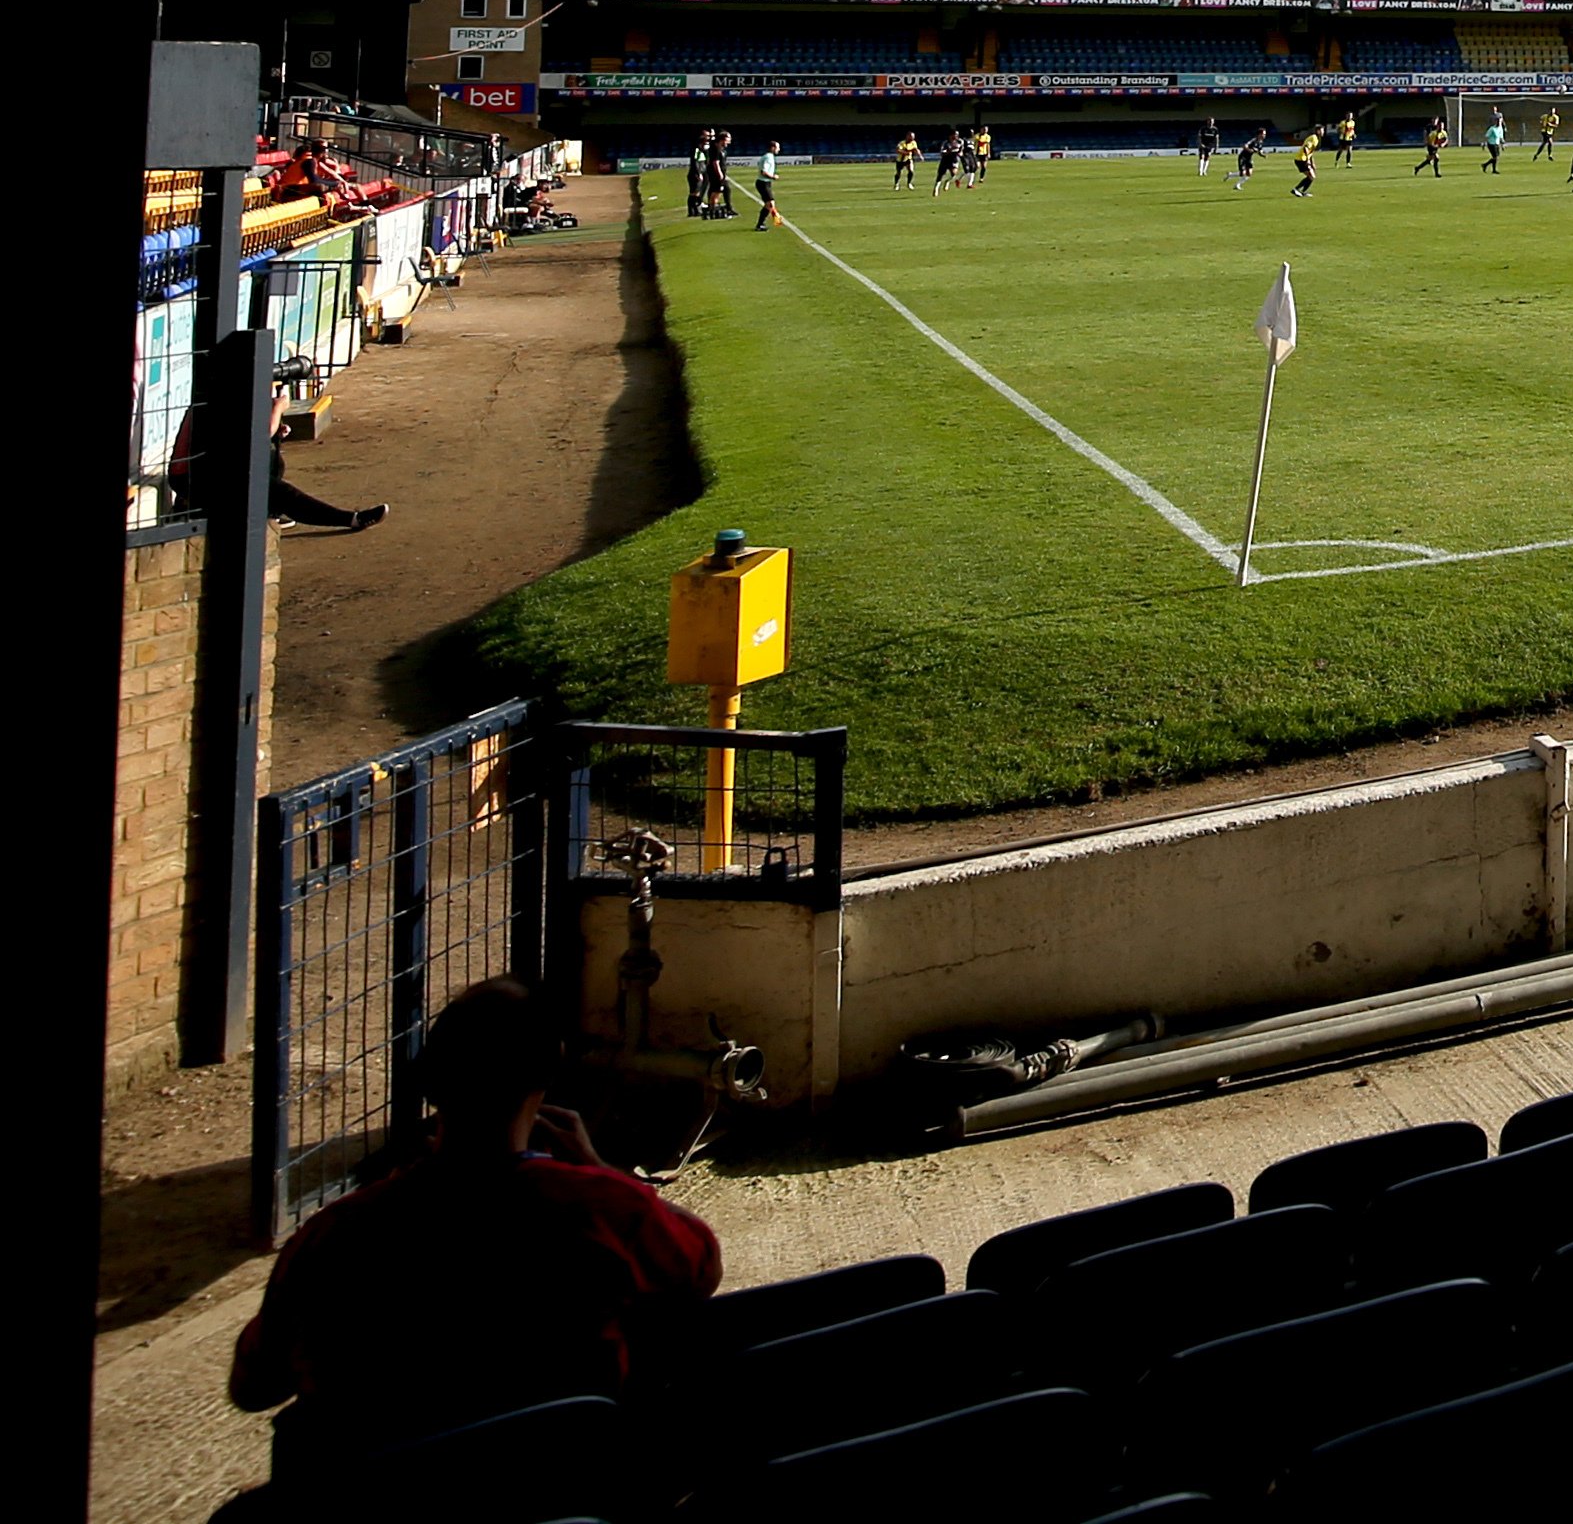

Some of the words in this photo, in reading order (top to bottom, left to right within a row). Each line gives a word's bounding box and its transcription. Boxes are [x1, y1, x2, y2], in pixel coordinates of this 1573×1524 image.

[457, 29, 492, 39] FIRST
[497, 29, 518, 39] AID
[468, 40, 506, 50] POINT
[715, 76, 733, 86] Mr
[763, 76, 787, 86] Lim
[888, 75, 1020, 87] PUKKA-PIES
[1052, 76, 1118, 86] Outstanding
[1121, 76, 1169, 86] Branding
[1262, 77, 1278, 85] LTD
[1286, 75, 1409, 86] TradePriceCars.com
[1417, 75, 1533, 85] TradePriceCars.com
[470, 88, 516, 106] bet
